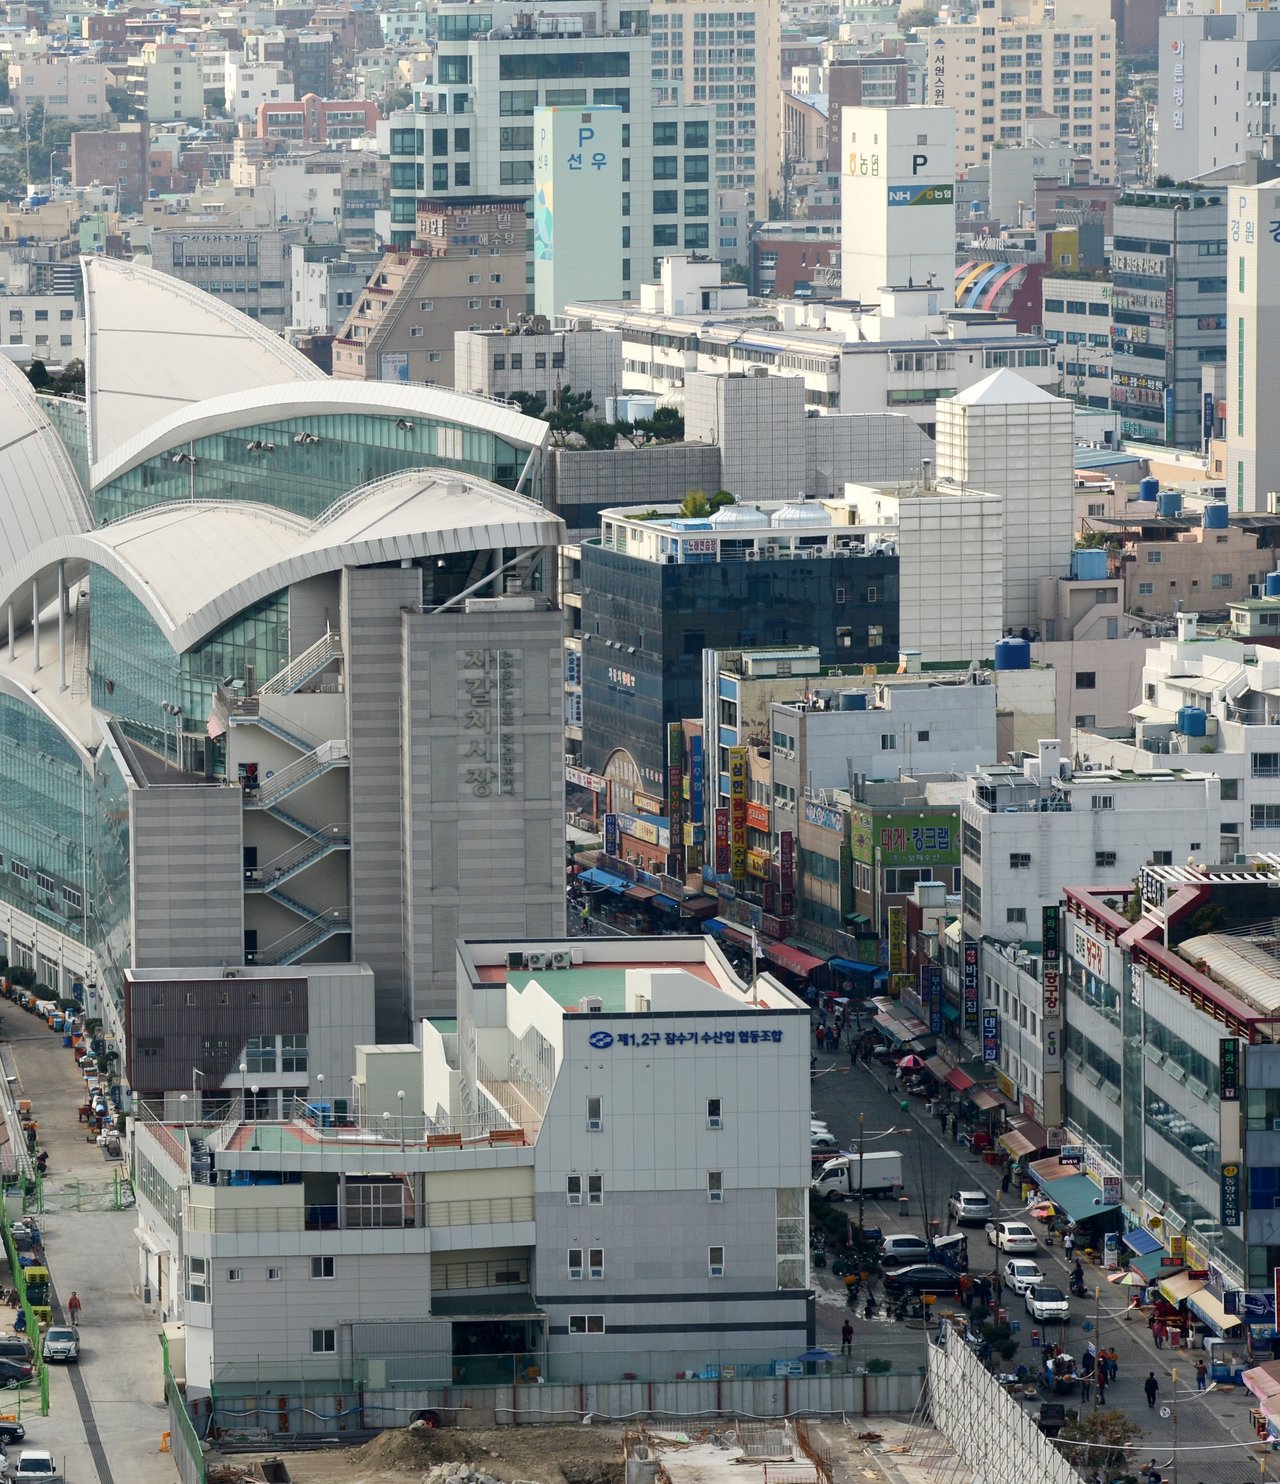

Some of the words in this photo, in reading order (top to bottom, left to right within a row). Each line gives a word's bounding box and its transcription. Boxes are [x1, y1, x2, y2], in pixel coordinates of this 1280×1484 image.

[579, 127, 595, 148] P
[567, 152, 607, 171] 선우
[860, 153, 879, 177] 농협
[912, 154, 928, 175] P
[889, 191, 910, 201] NH
[934, 189, 952, 199] 농협
[1239, 196, 1247, 218] P
[1231, 220, 1255, 244] 경원
[688, 540, 716, 551] 노래연습장
[502, 651, 514, 726] JAGALCHI
[464, 649, 497, 798] 자갈치시장
[502, 733, 515, 797] MARKET
[1086, 937, 1103, 975] 당구장
[1045, 972, 1059, 1009] 당구장
[617, 1033, 661, 1047] 제1,2구
[664, 1032, 699, 1045] 잠수기
[700, 1031, 735, 1044] 수산업
[738, 1030, 783, 1044] 협동조합
[1225, 1041, 1235, 1074] 테라스
